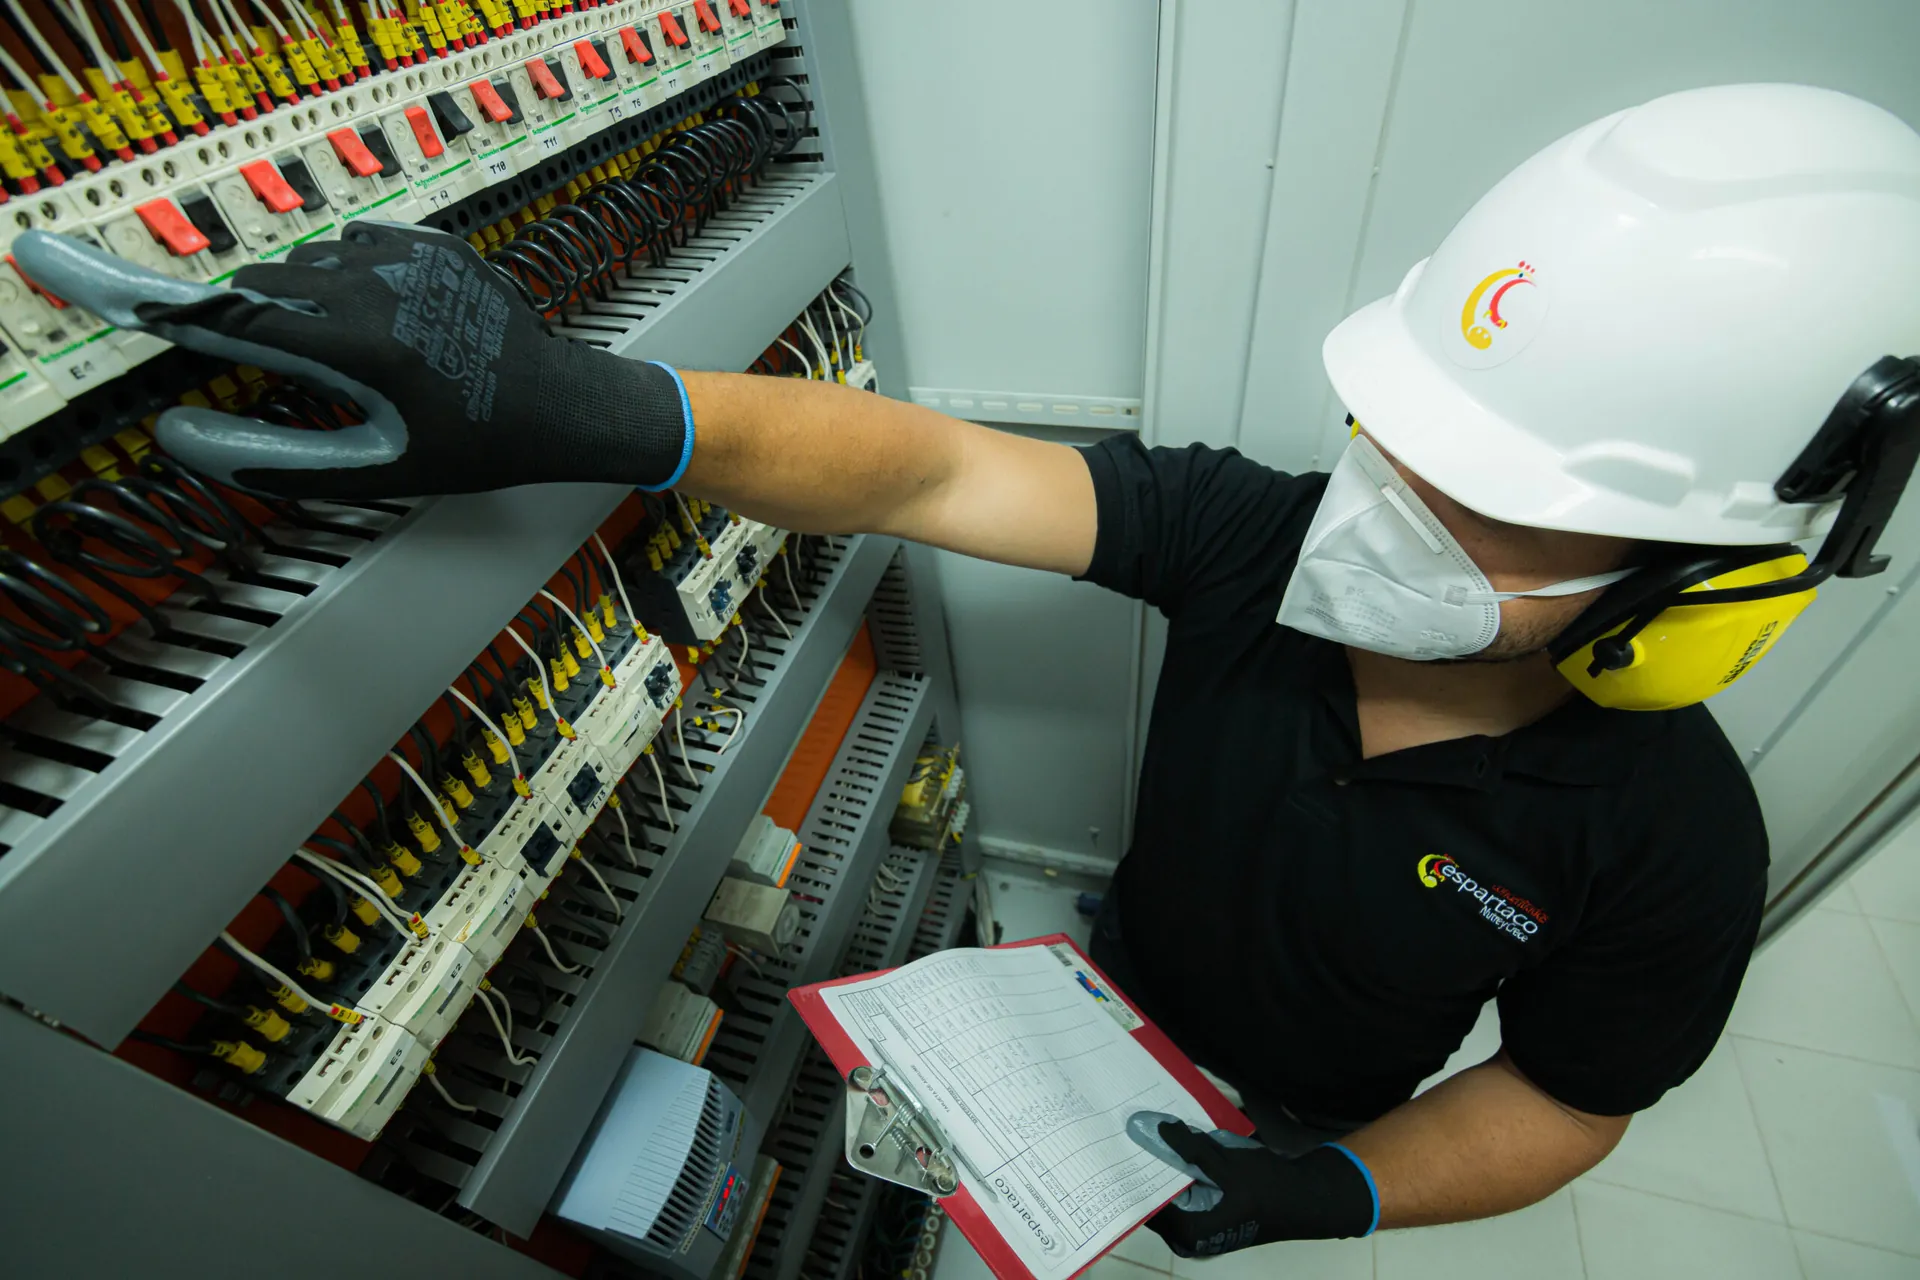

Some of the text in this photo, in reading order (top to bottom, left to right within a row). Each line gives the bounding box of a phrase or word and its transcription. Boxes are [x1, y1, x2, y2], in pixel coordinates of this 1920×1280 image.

[668, 78, 678, 89] T7
[632, 98, 642, 109] T6
[543, 136, 559, 149] T11
[477, 147, 501, 162] Schneider
[490, 160, 508, 174] T10
[414, 172, 441, 188] Schneider
[342, 204, 372, 222] Schneider
[1724, 622, 1778, 684] STEELPRO
[589, 789, 608, 810] T-13
[502, 888, 518, 908] T12
[1442, 864, 1538, 934] espartaco
[450, 962, 464, 980] E2
[390, 1046, 404, 1065] E5
[994, 1178, 1050, 1246] espartaco
